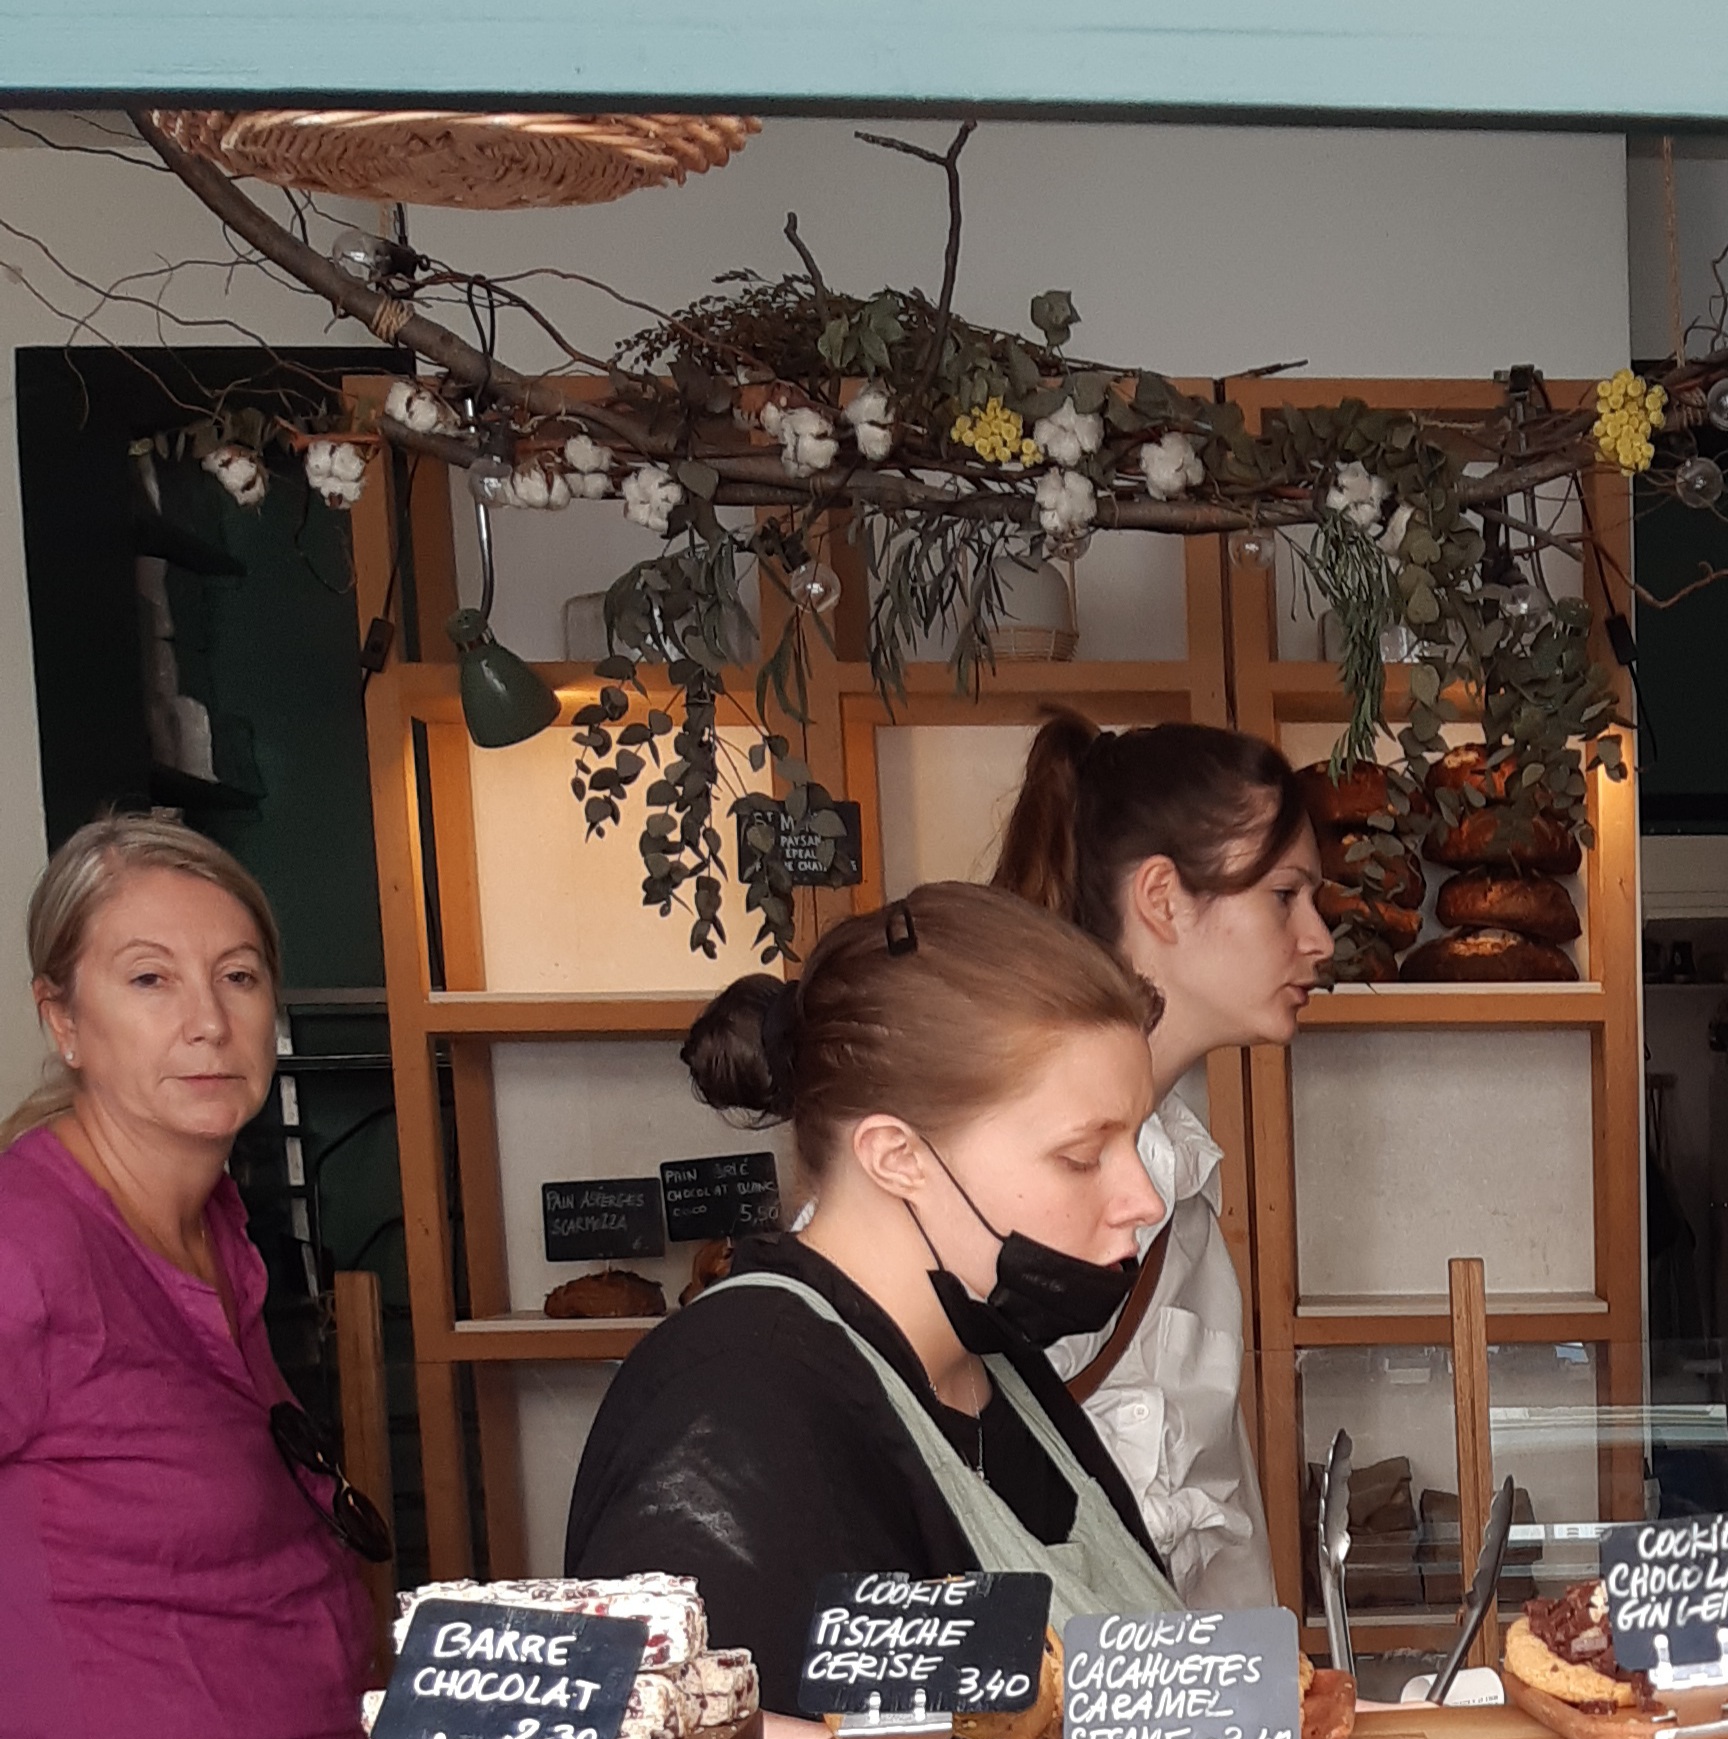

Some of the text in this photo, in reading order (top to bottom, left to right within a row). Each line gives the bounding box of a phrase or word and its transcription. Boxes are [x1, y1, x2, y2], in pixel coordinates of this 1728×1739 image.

[665, 1168, 698, 1183] PAIN
[666, 1184, 728, 1202] CHOCOLAT
[854, 1573, 977, 1606] COOKIE
[433, 1621, 578, 1667] BARRE
[815, 1606, 975, 1649] PISTACHE
[1100, 1614, 1224, 1651] COOKIE
[806, 1650, 1031, 1702] CERISE 3,40
[1067, 1652, 1263, 1690] CACAHUETES
[412, 1667, 601, 1713] CHOCOLAT
[1068, 1687, 1234, 1723] CARAMEL
